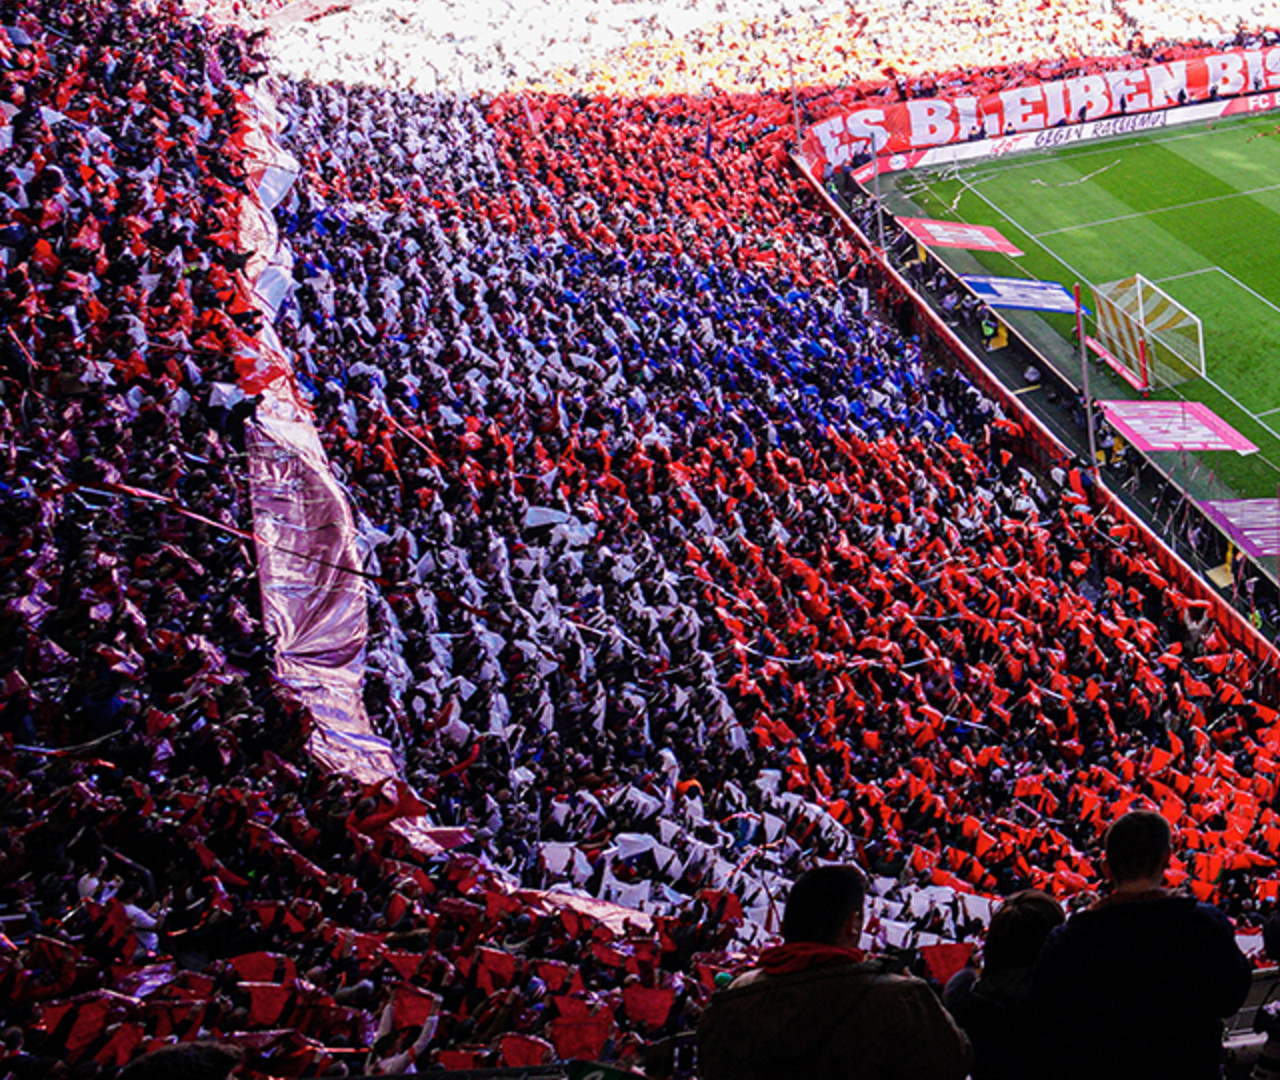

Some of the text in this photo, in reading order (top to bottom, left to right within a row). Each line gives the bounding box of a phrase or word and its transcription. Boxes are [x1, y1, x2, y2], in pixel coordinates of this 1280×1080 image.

[812, 108, 888, 167] ES
[907, 60, 1187, 146] BLEIBEN
[1248, 94, 1270, 110] FC
